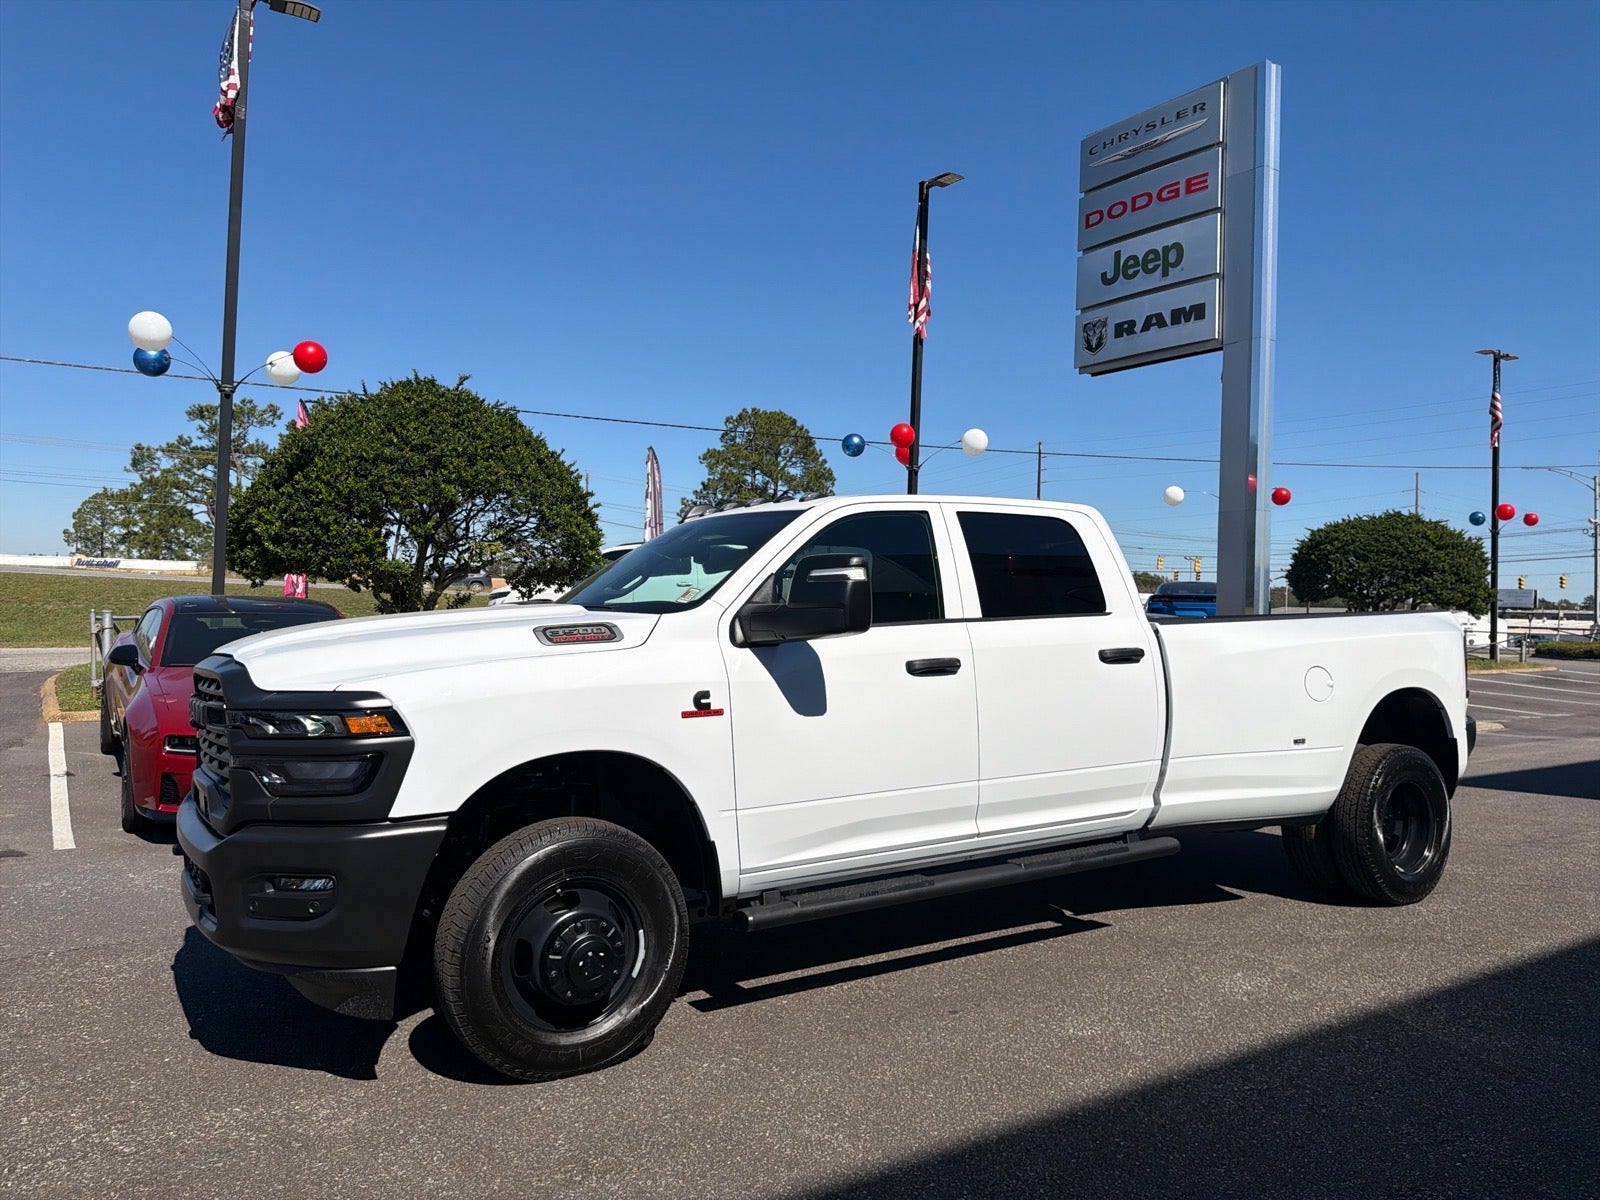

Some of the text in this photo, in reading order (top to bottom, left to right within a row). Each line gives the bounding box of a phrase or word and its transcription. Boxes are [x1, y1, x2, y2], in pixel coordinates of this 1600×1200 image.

[1088, 102, 1207, 156] CHRYSLER
[1084, 172, 1209, 229] DODGE
[1100, 240, 1185, 287] Jeep
[1113, 302, 1206, 339] RAM
[549, 627, 607, 637] 3500
